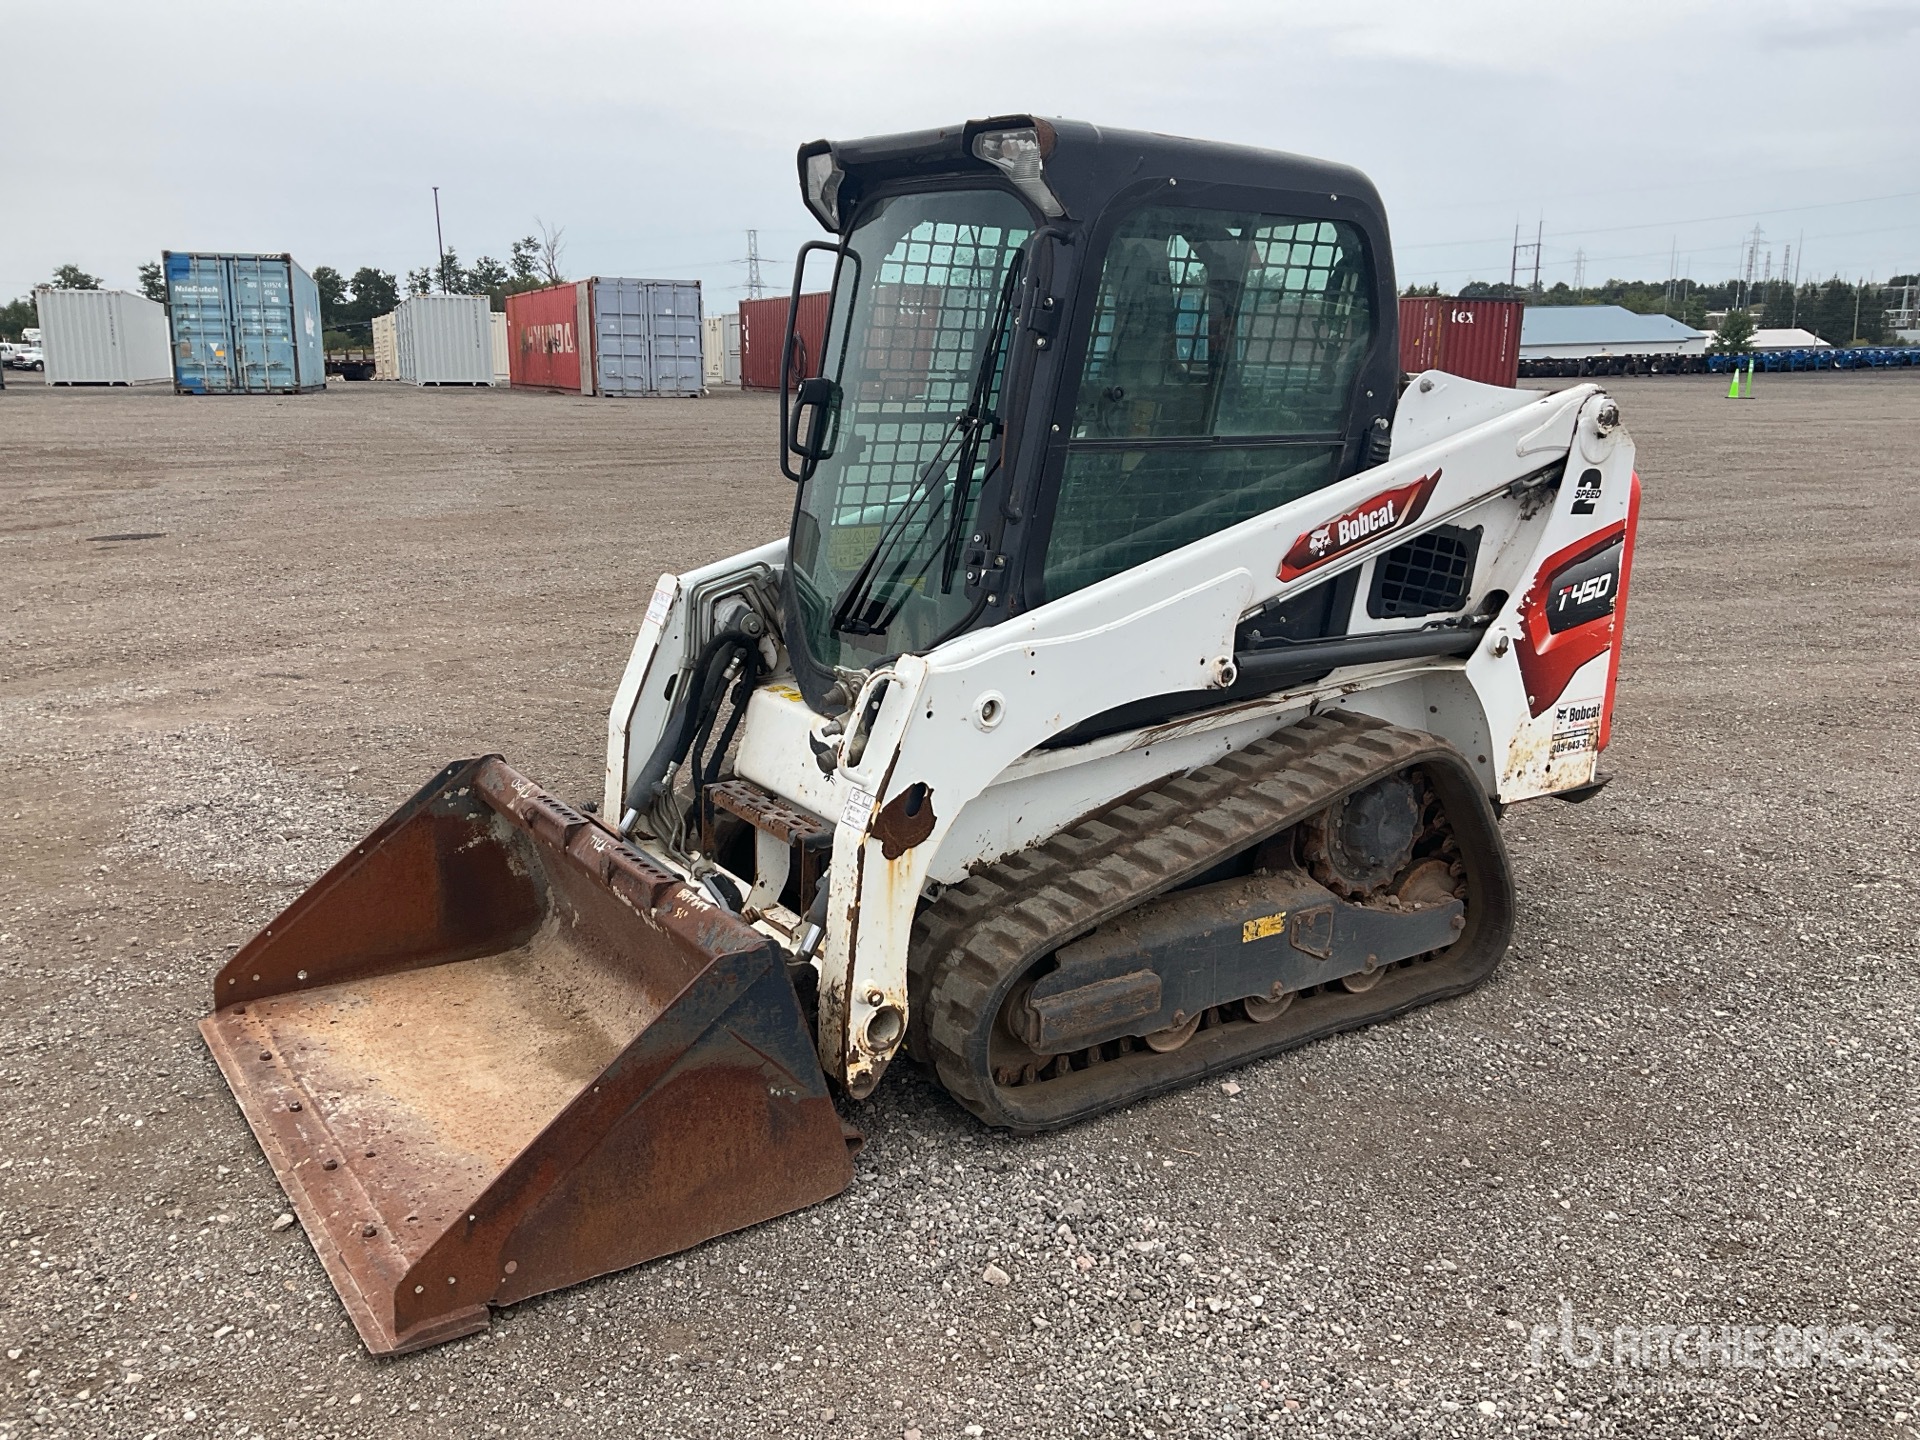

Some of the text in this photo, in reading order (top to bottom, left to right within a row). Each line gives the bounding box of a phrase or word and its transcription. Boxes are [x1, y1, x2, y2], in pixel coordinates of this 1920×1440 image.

[1451, 308, 1474, 324] tex
[1574, 489, 1601, 499] SPEED
[1337, 500, 1395, 546] Bobcat
[1558, 572, 1612, 612] T450
[1569, 703, 1601, 723] Bobcat
